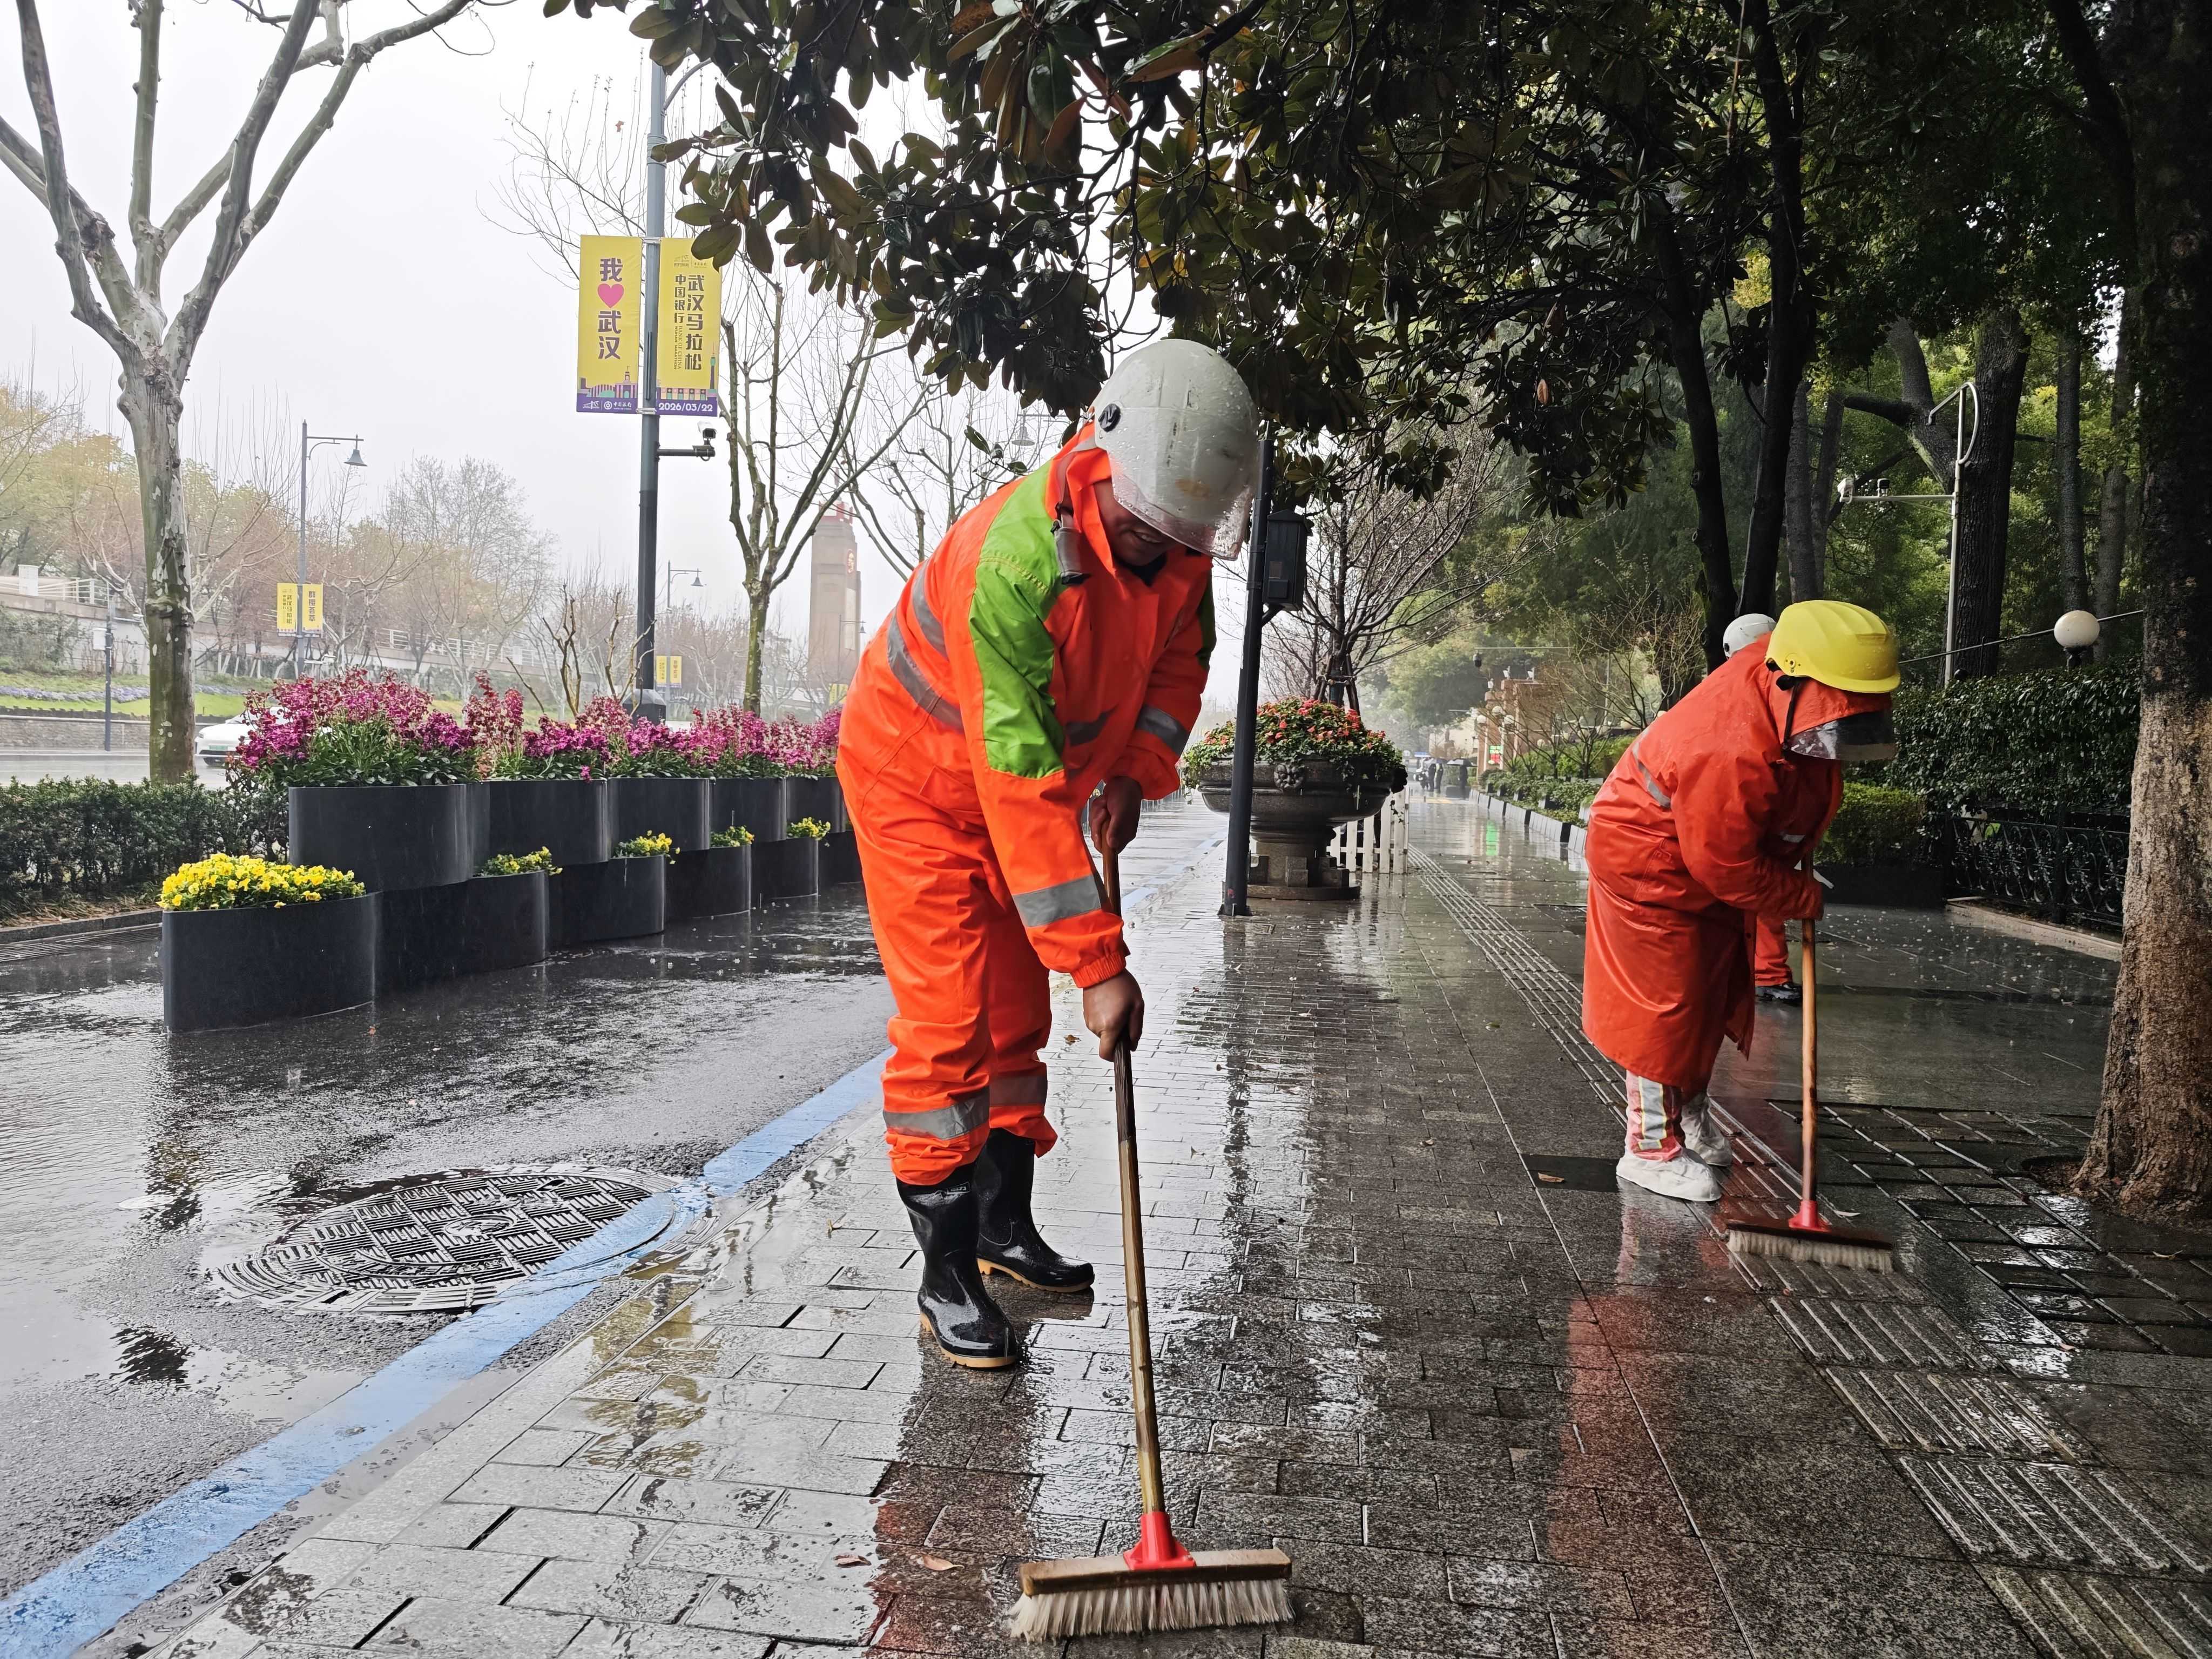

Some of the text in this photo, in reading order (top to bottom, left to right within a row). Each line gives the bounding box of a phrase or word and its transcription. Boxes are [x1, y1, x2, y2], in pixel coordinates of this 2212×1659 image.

[598, 258, 623, 360] 我 武汉
[673, 274, 686, 323] 中国银行
[685, 274, 705, 370] 武汉马拉松
[658, 402, 713, 412] 2026/03/22
